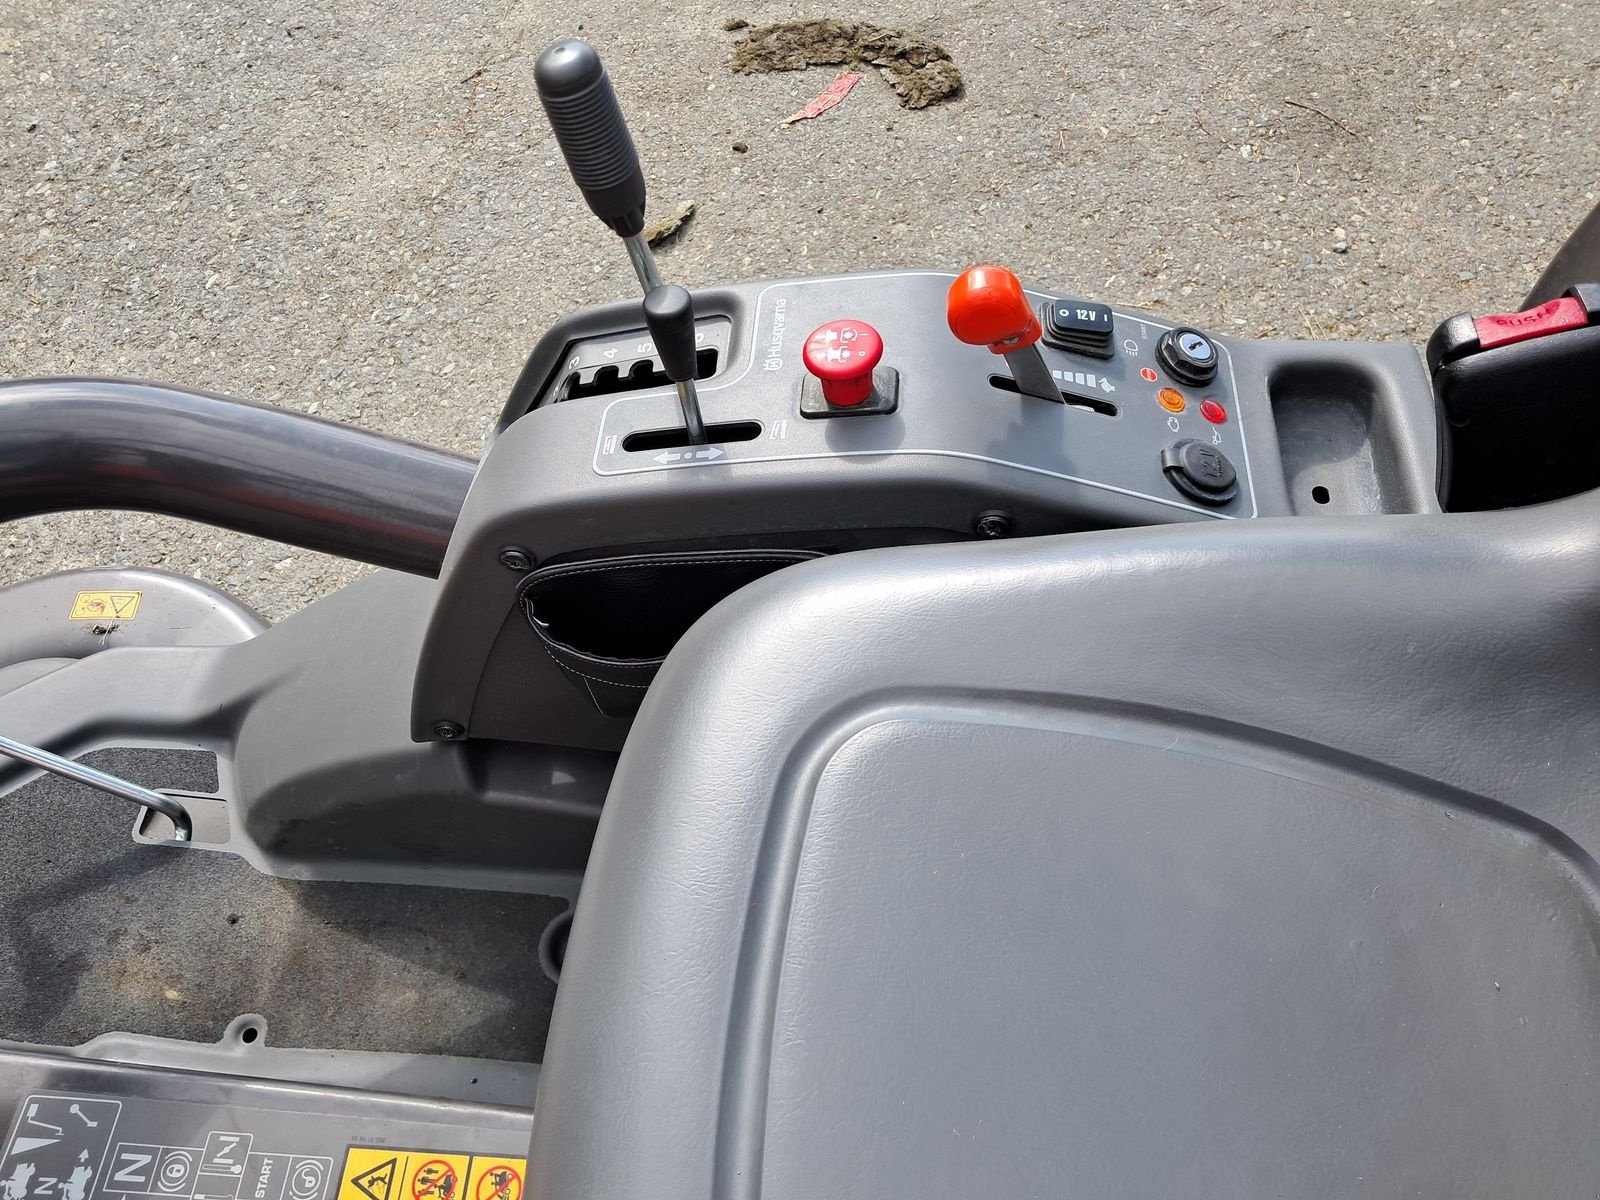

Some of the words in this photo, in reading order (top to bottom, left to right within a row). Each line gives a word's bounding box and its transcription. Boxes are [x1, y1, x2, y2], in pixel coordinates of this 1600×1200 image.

[1075, 308, 1096, 322] 12V
[1495, 307, 1552, 326] PUSH
[767, 297, 788, 358] Husqvarna
[602, 347, 618, 359] 4
[637, 342, 652, 353] 5
[568, 355, 580, 369] 3
[255, 1157, 274, 1199] START
